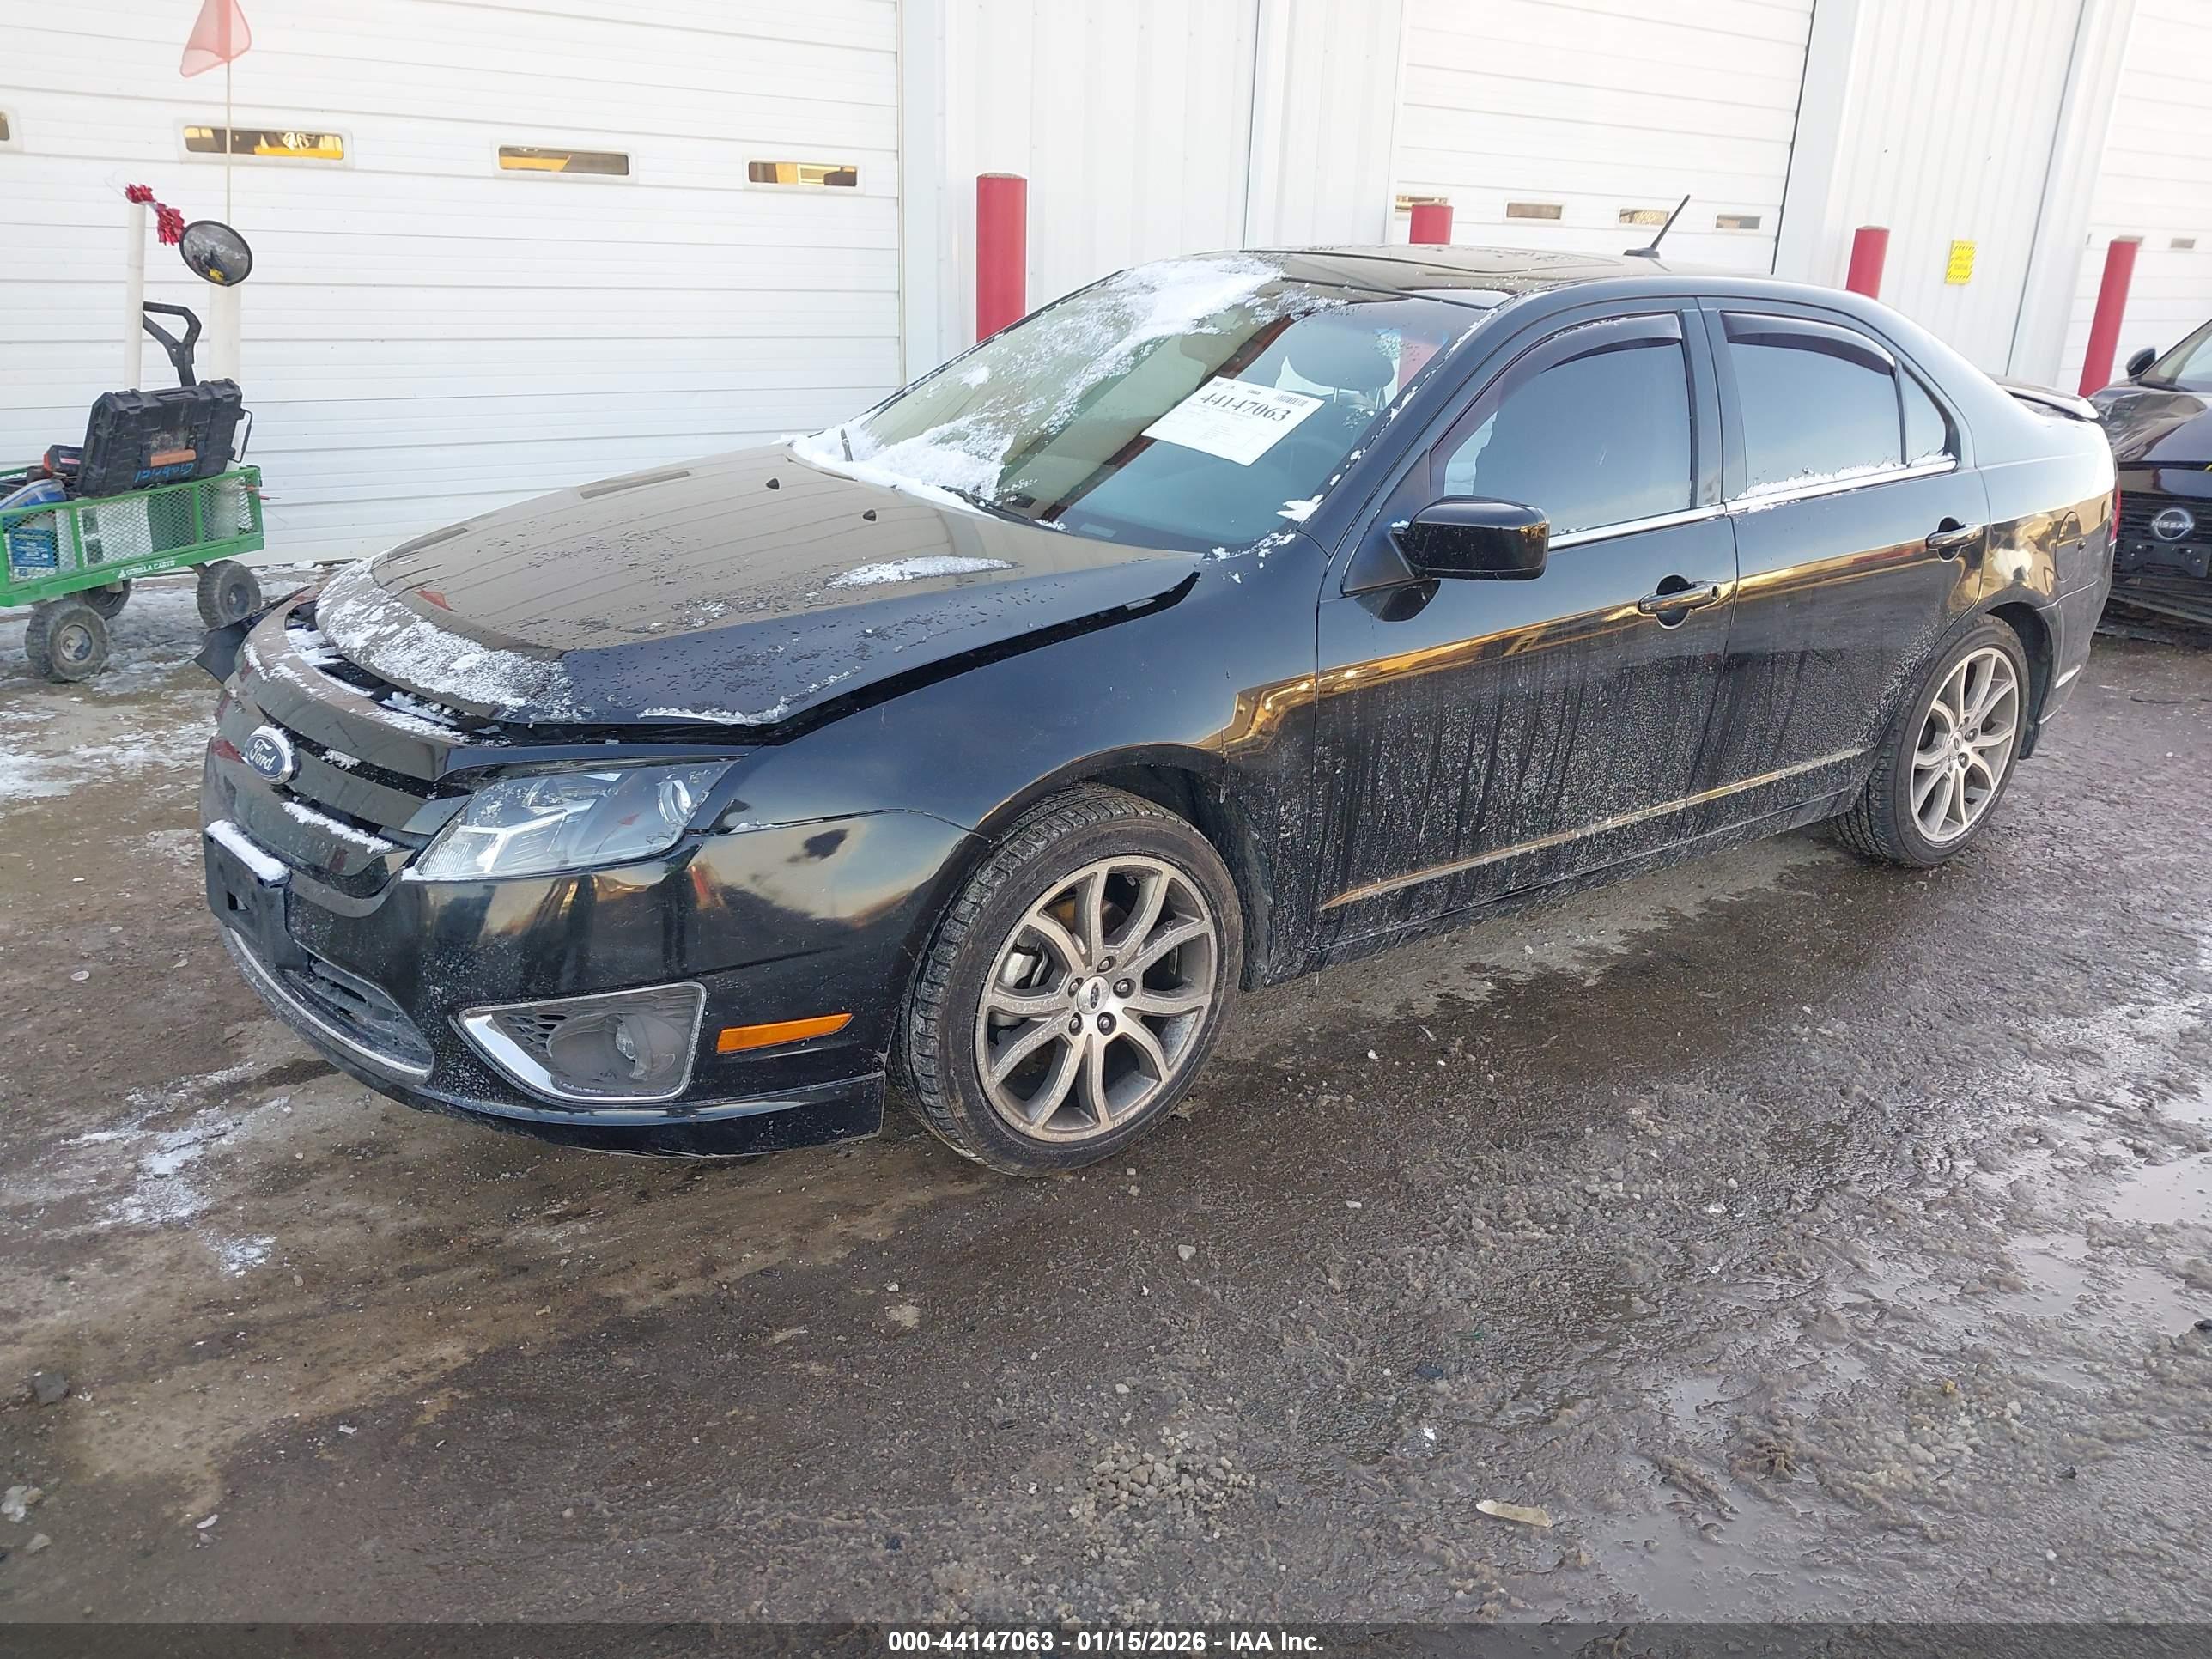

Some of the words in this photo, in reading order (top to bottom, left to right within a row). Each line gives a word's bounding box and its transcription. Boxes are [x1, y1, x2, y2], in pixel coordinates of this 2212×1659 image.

[1200, 392, 1291, 422] 44147063
[134, 463, 194, 483] Gabriel
[2151, 520, 2195, 530] NISSAN
[249, 738, 276, 771] Ford
